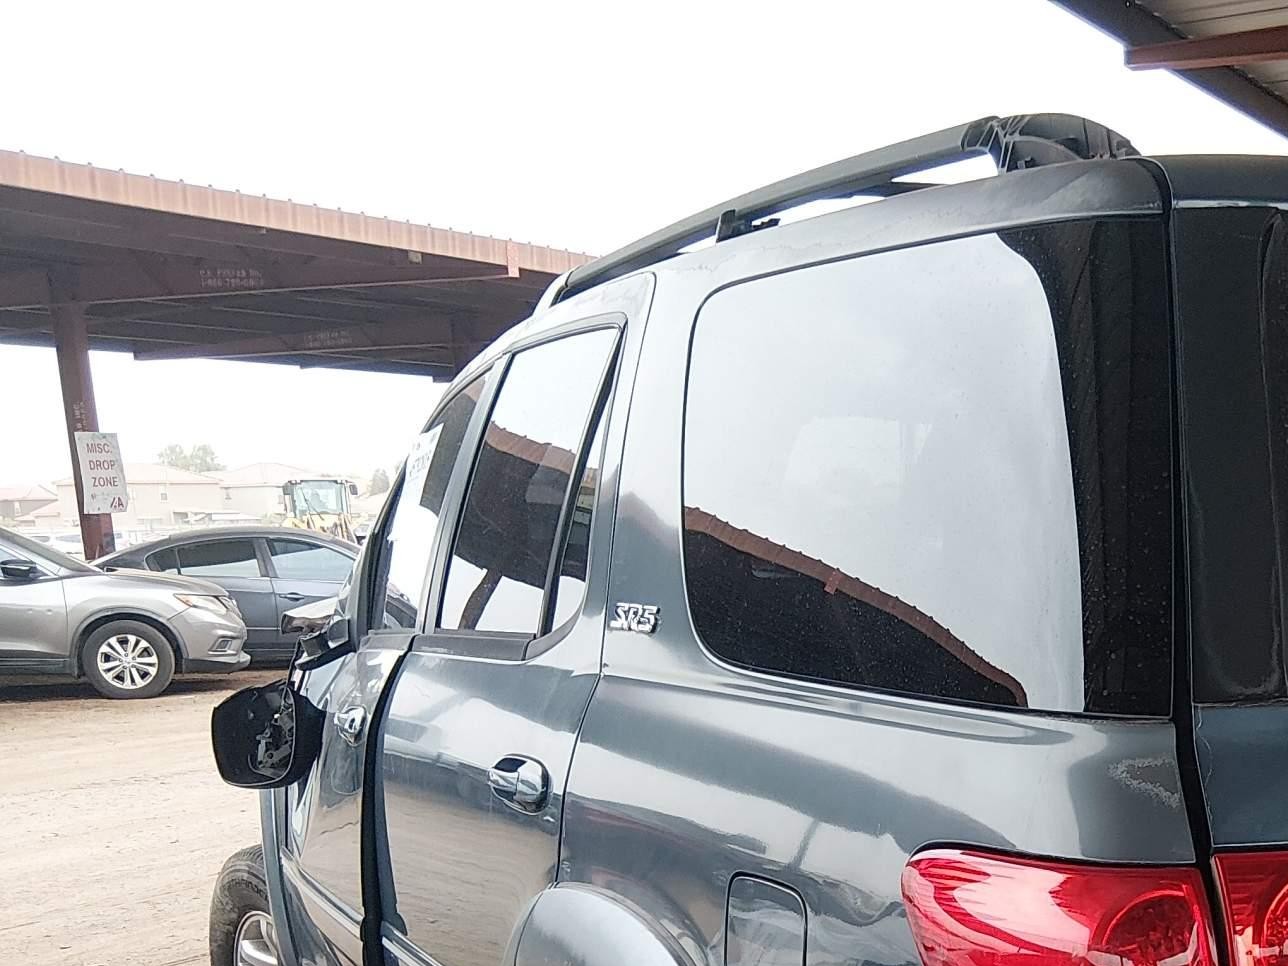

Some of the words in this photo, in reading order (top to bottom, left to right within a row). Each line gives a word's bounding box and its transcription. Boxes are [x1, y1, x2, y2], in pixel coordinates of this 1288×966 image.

[86, 443, 113, 454] MISC.
[88, 460, 116, 471] DROP
[92, 476, 119, 488] ZONE
